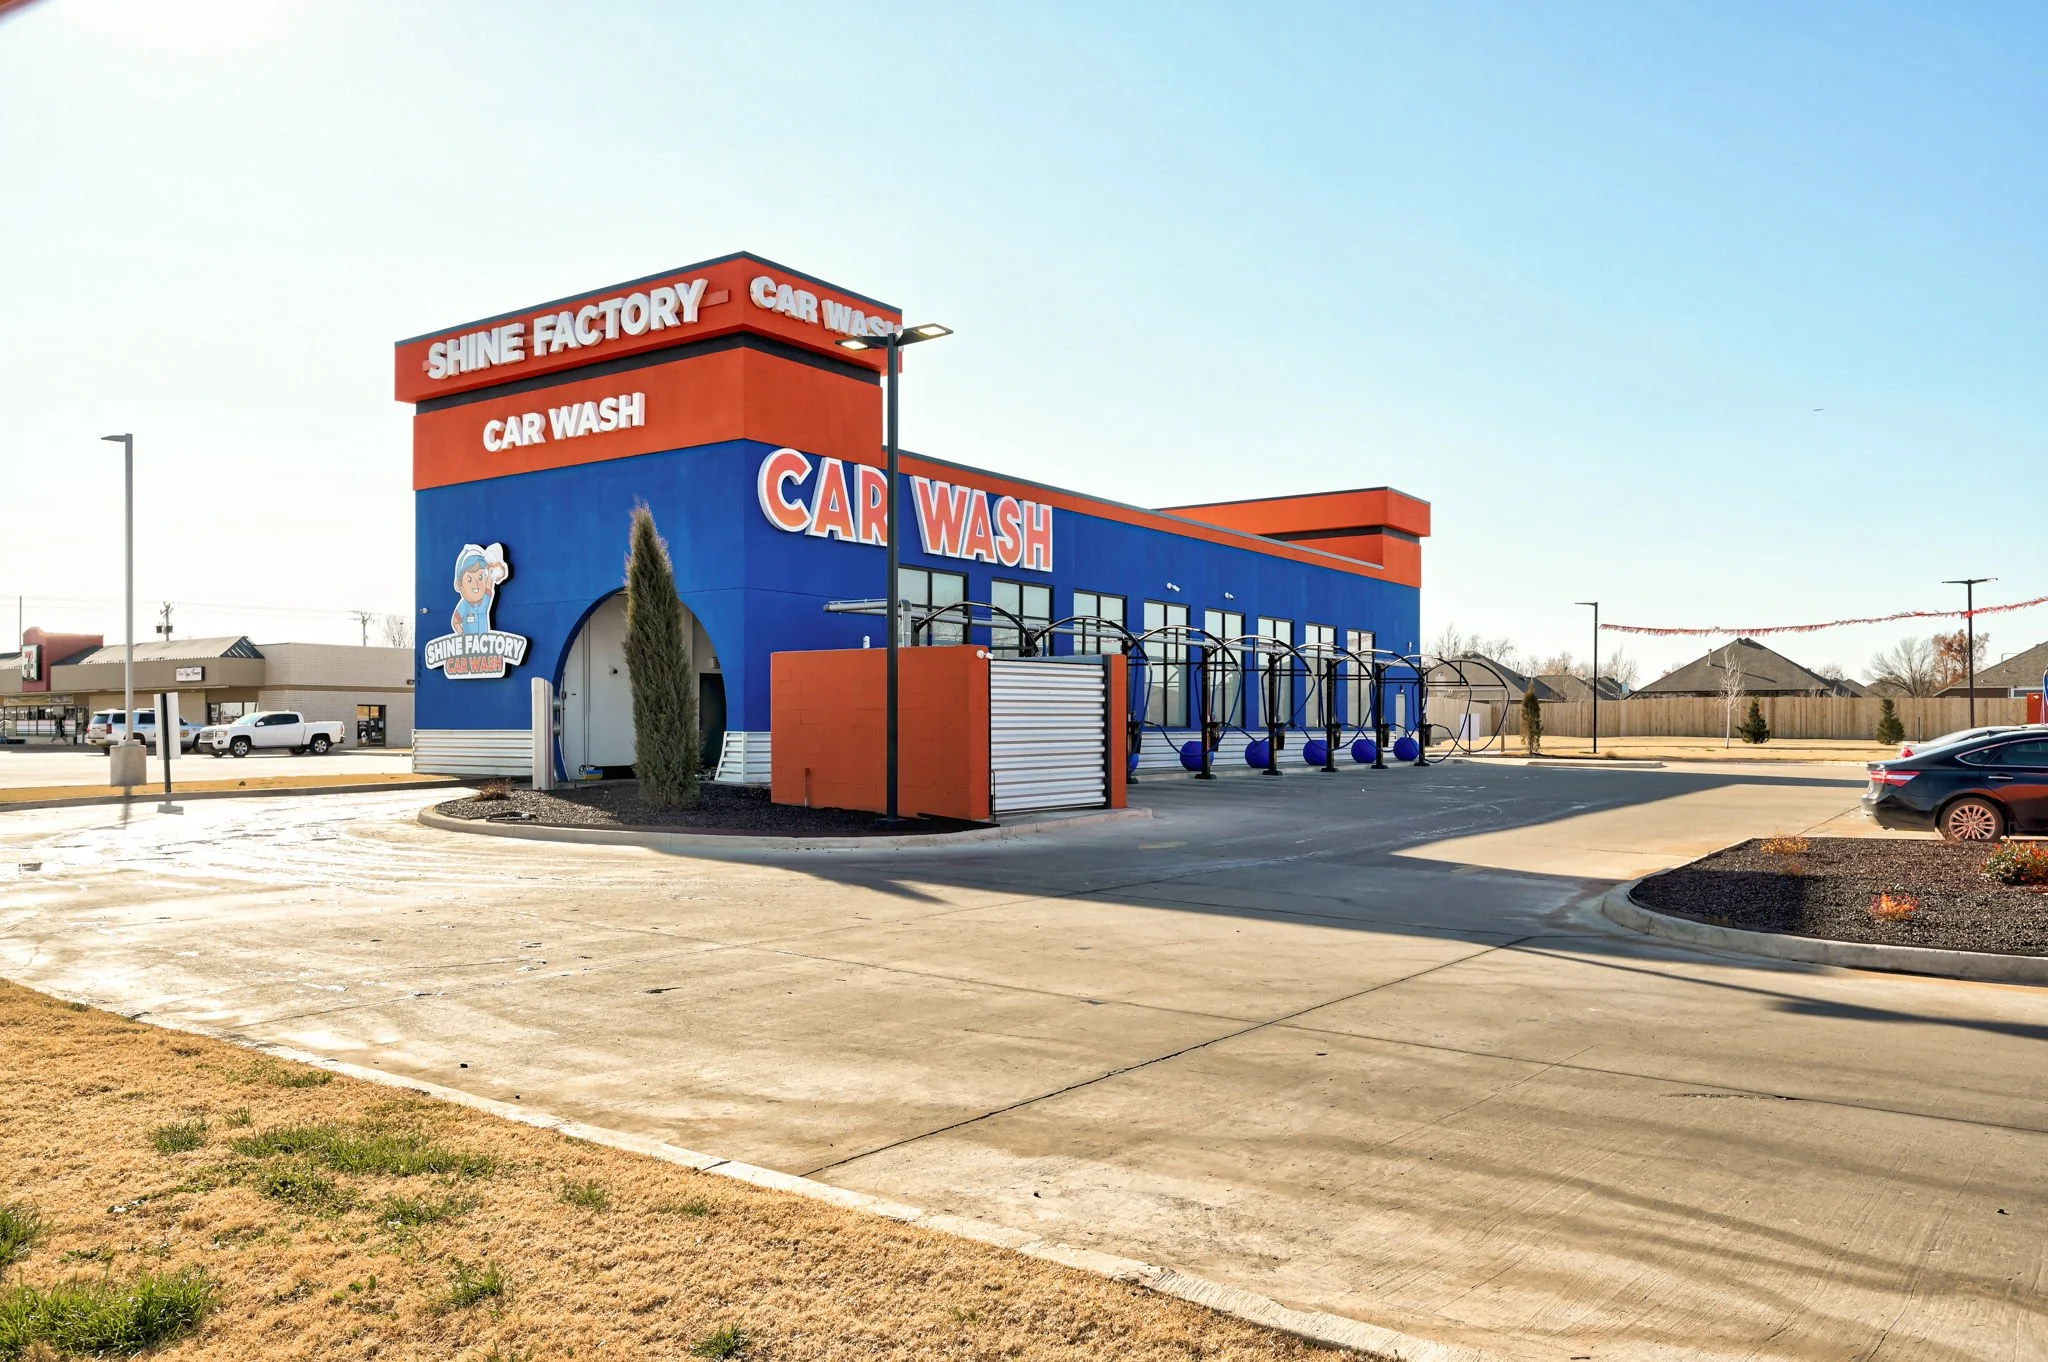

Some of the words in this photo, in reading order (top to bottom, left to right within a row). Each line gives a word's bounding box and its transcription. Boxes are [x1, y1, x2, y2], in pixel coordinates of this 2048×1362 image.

[750, 276, 818, 324] CAR
[428, 322, 525, 380] SHINE
[533, 278, 708, 357] FACTORY
[483, 412, 546, 452] CAR
[548, 392, 645, 440] WASH
[758, 447, 888, 547] CAR
[909, 475, 1053, 572] WASH
[427, 636, 463, 663] SHINE
[465, 634, 523, 659] FACTORY
[446, 657, 468, 673] CAR
[469, 655, 503, 672] WASH
